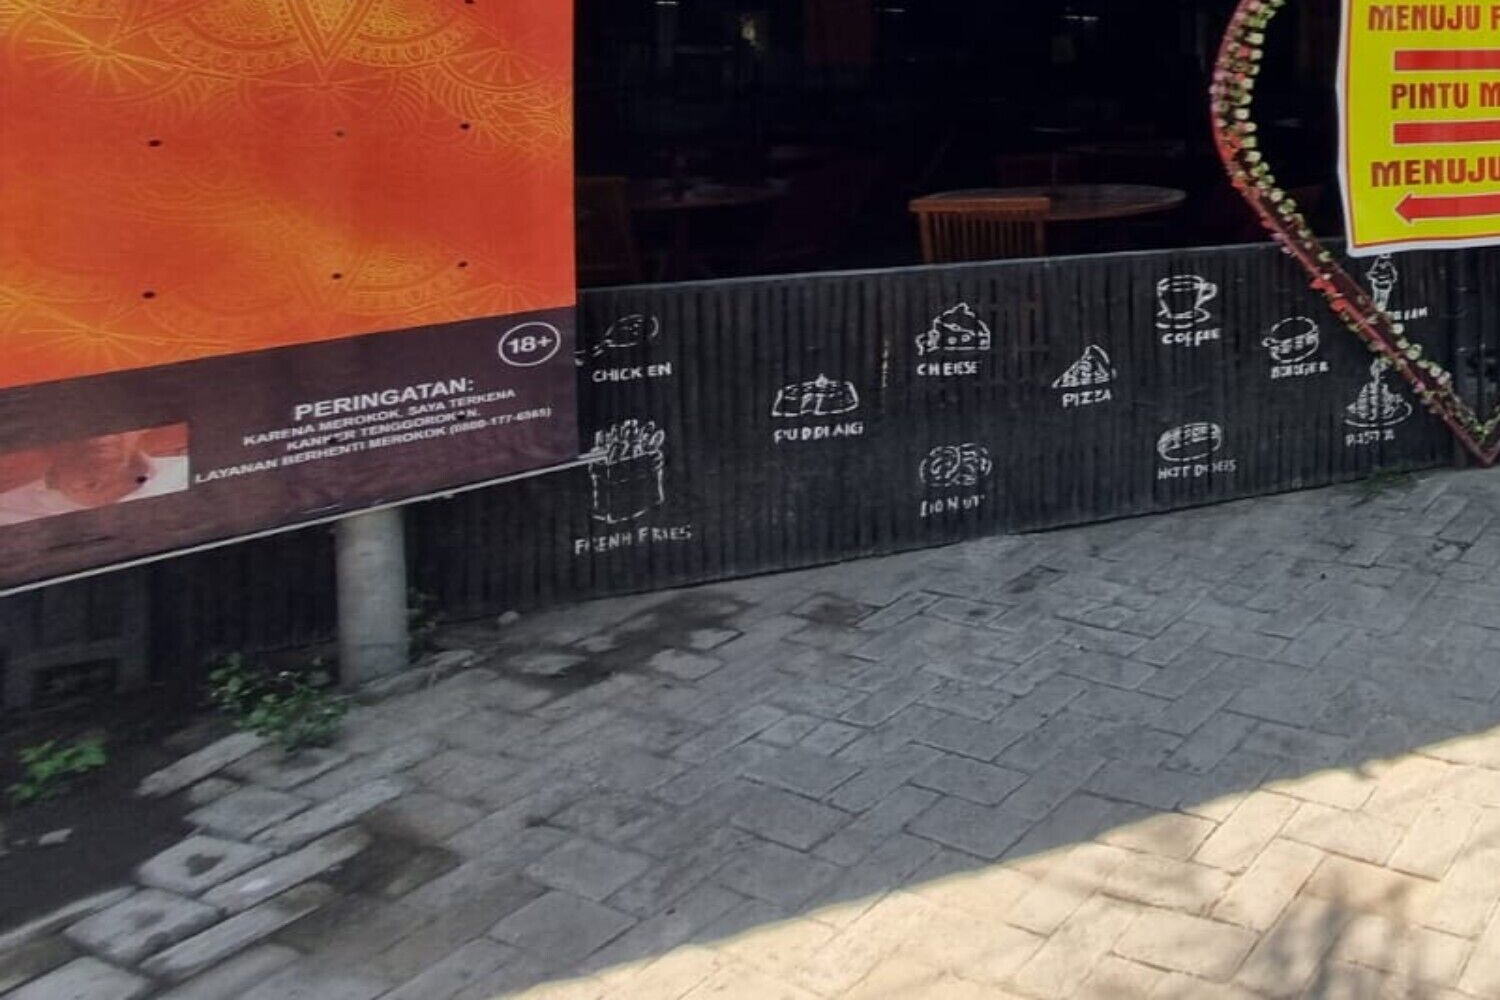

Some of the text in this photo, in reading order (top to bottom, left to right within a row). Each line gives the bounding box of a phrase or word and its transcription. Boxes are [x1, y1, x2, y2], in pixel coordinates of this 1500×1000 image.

[1367, 4, 1481, 32] MENUJU
[1390, 82, 1470, 110] PINTU
[507, 336, 553, 354] 18+
[294, 377, 475, 421] PERINGATAN:
[1062, 388, 1113, 408] PIZZA
[243, 425, 316, 447] KARENA
[408, 401, 447, 417] SAYA
[450, 388, 517, 409] TERKENA
[194, 456, 280, 484] LAYANAN
[281, 439, 366, 467] BERHENTI
[369, 426, 447, 450] MEROKOK
